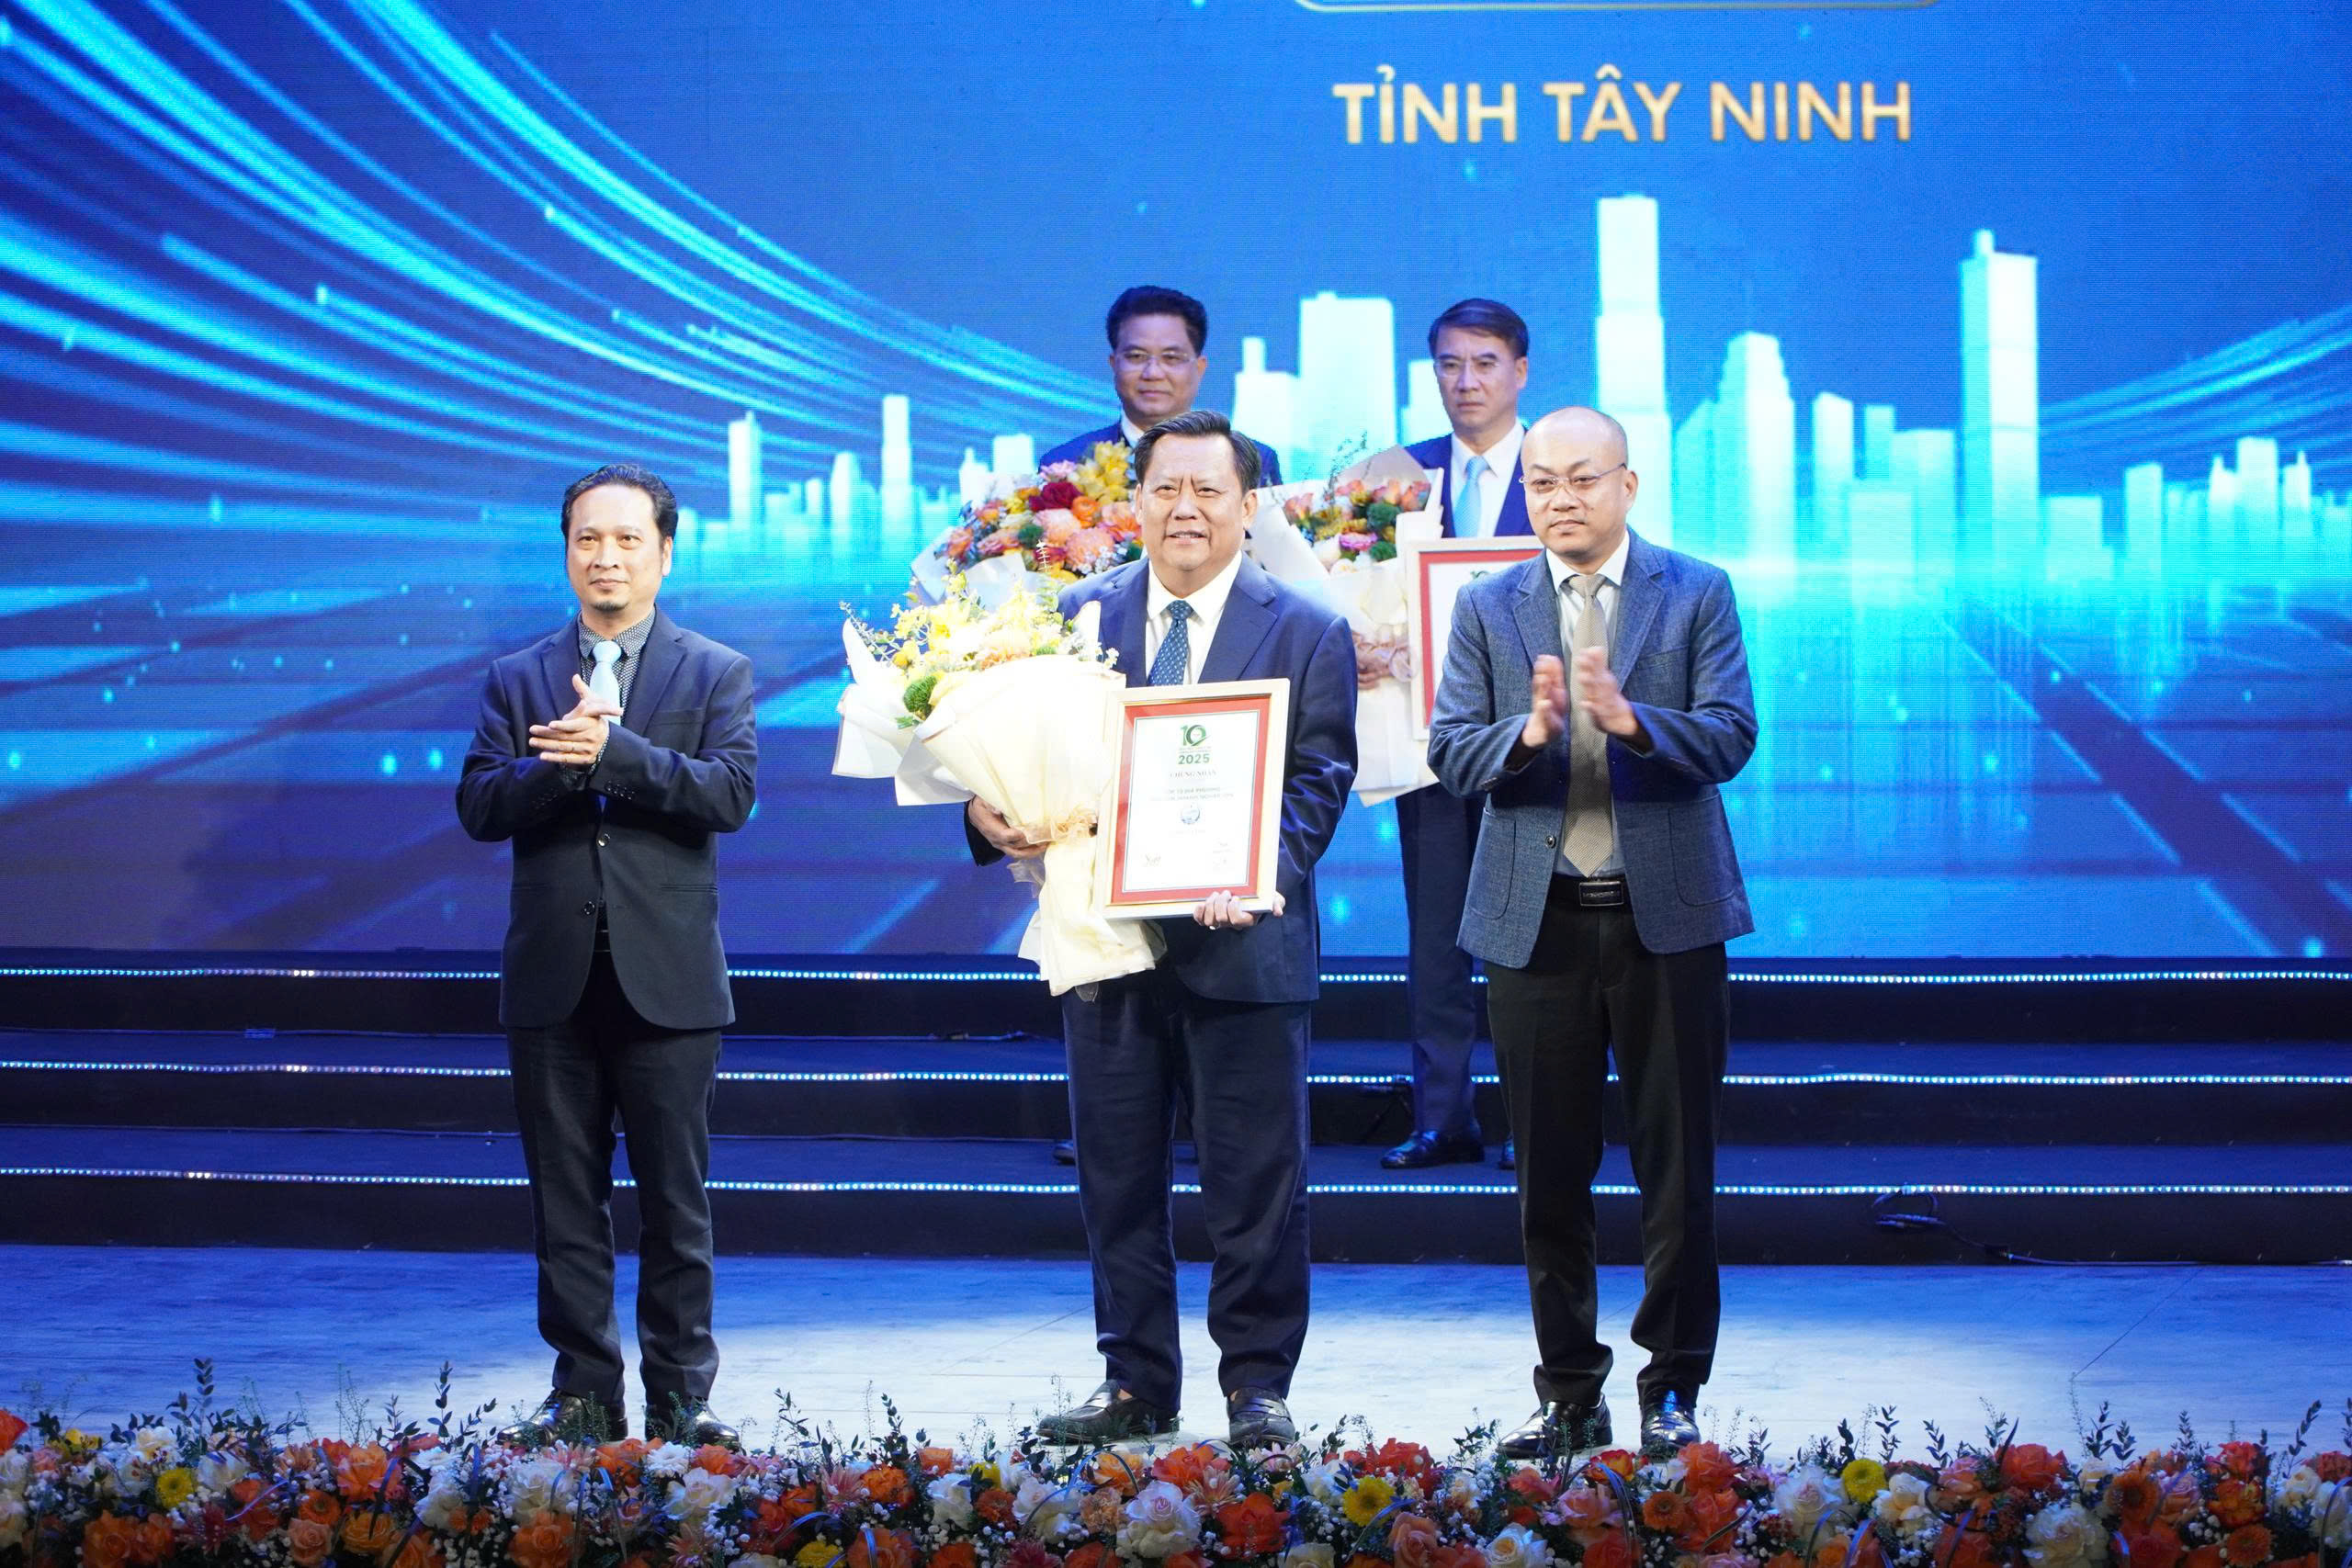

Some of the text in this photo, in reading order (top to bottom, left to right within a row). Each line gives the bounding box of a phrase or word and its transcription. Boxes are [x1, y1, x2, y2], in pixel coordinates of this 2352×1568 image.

[1332, 63, 1911, 143] TỈNH TÂY NINH
[1178, 753, 1211, 765] 2025
